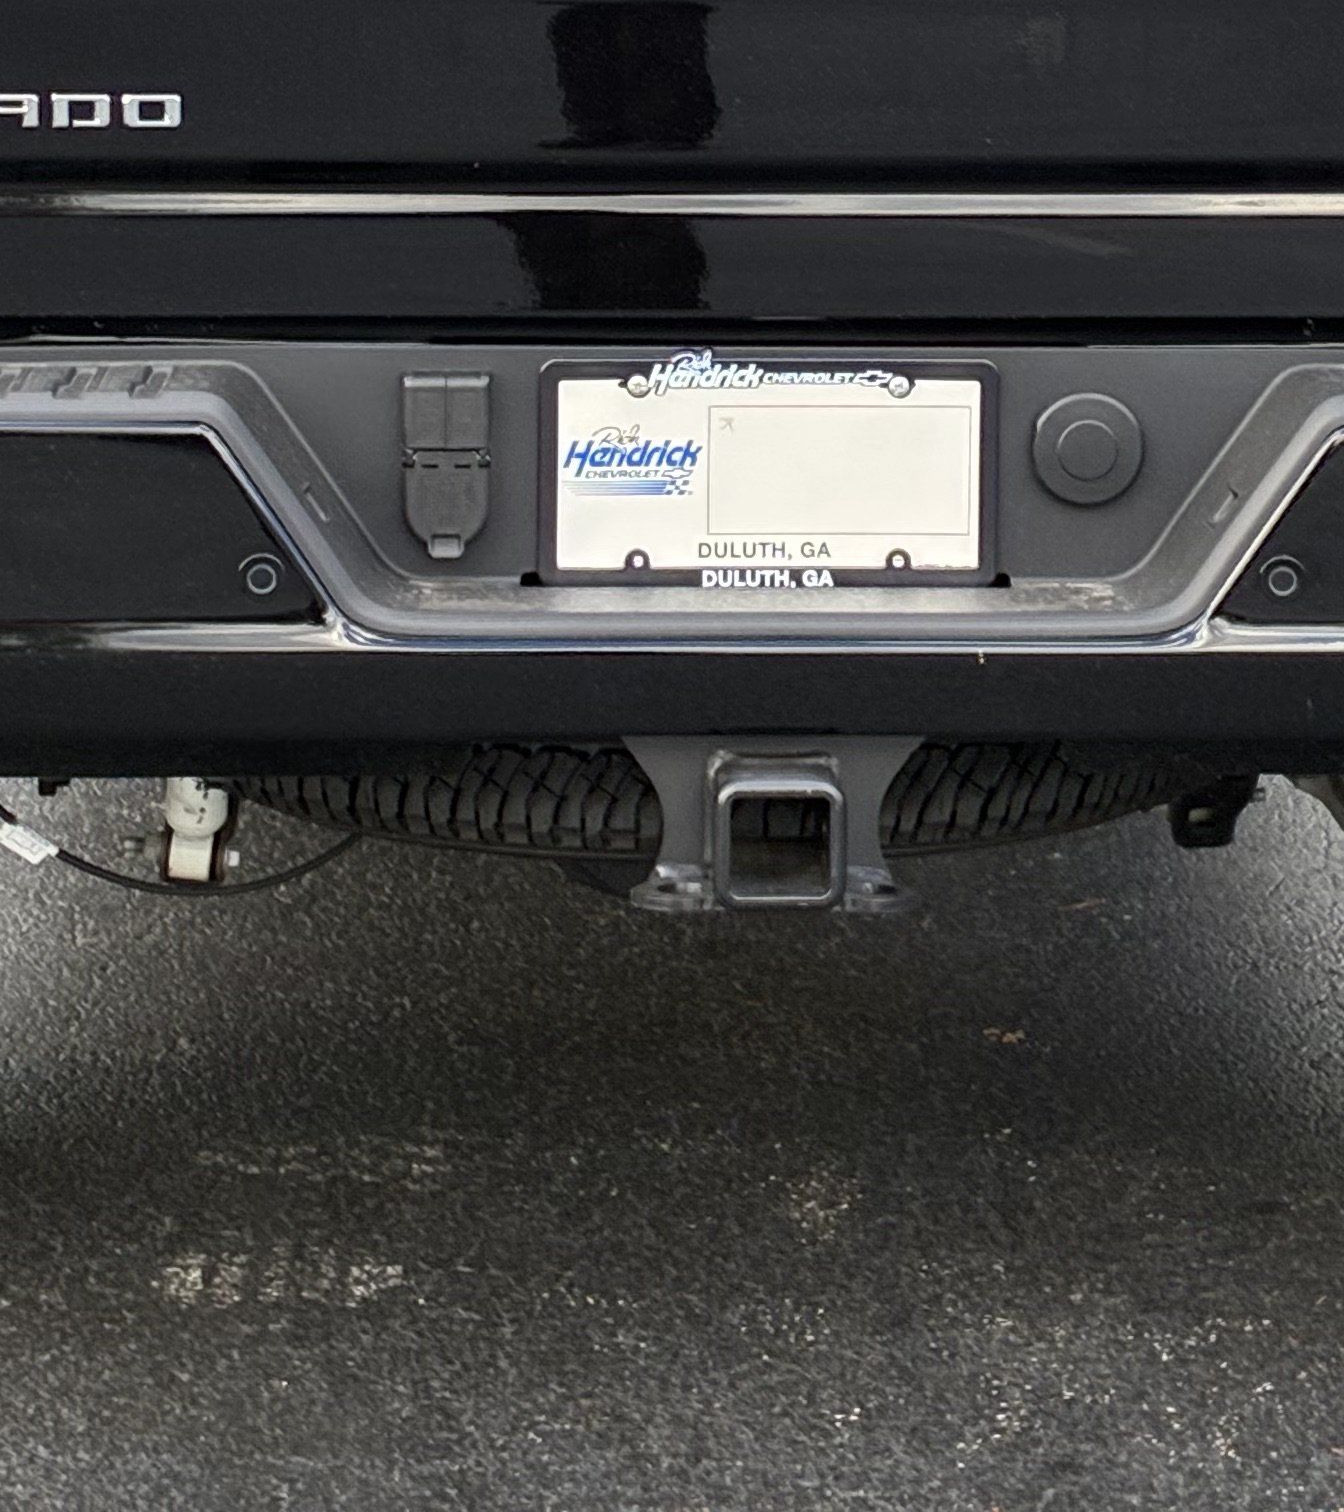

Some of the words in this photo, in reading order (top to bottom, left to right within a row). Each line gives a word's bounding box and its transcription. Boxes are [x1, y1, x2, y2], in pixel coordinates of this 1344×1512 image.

[647, 363, 764, 396] Hendrick
[763, 372, 853, 385] CHEVROLET
[563, 439, 703, 478] Hendrick
[585, 469, 659, 479] CHEVROLET
[698, 542, 793, 560] DULUTH,
[801, 542, 831, 558] GA
[702, 570, 796, 588] DULUTH,
[802, 570, 834, 587] GA
